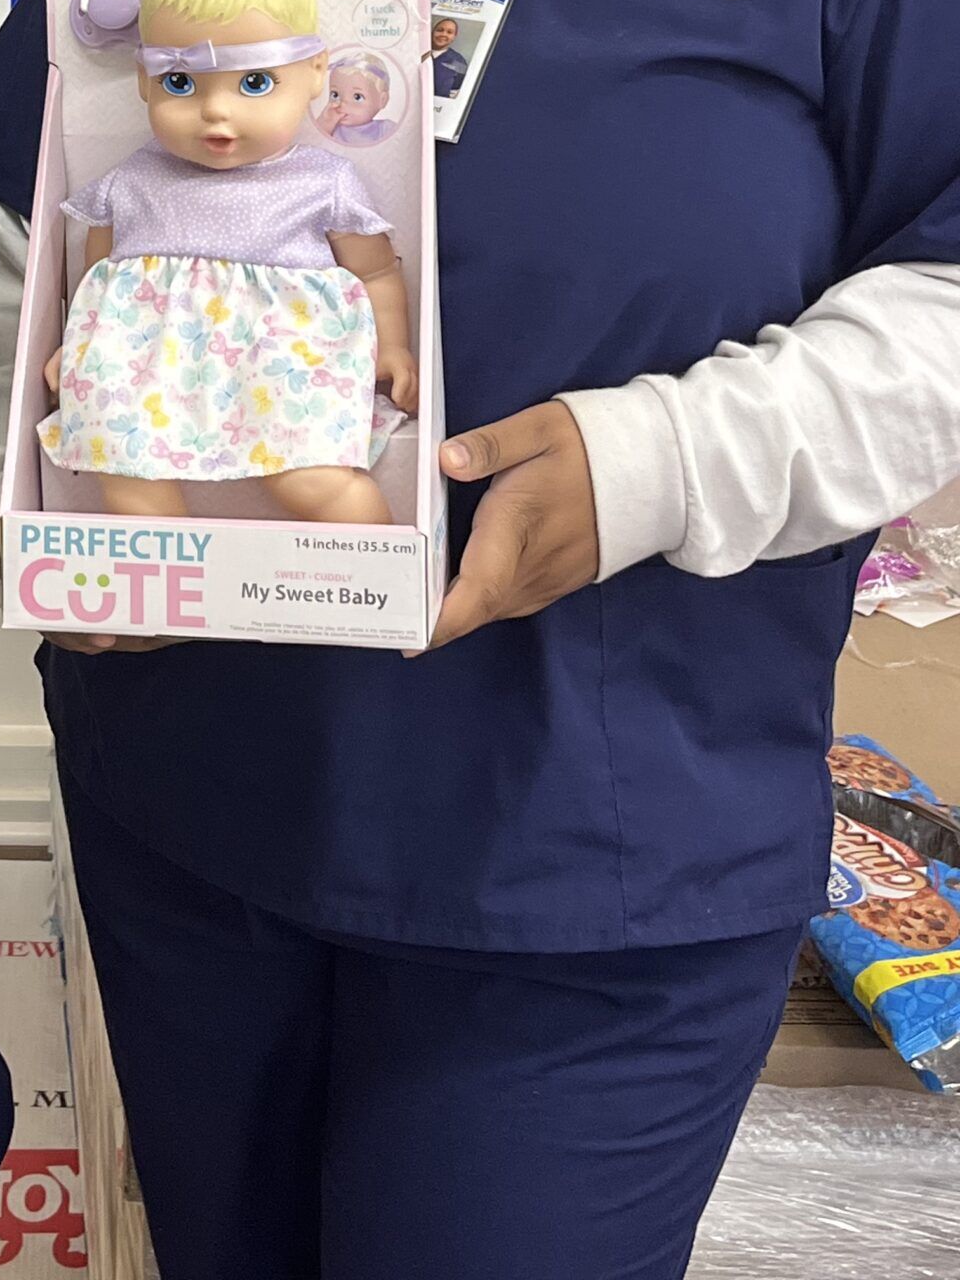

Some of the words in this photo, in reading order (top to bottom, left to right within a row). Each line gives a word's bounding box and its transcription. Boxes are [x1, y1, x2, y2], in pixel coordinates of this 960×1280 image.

[21, 524, 213, 563] PERFECTLY
[295, 537, 310, 549] 14
[313, 538, 355, 551] inches
[357, 540, 390, 554] (35.5
[393, 542, 417, 556] cm)
[19, 557, 206, 629] CUTE
[241, 582, 270, 604] My
[275, 584, 334, 604] Sweet
[339, 587, 388, 610] Baby
[891, 961, 940, 977] SIZE
